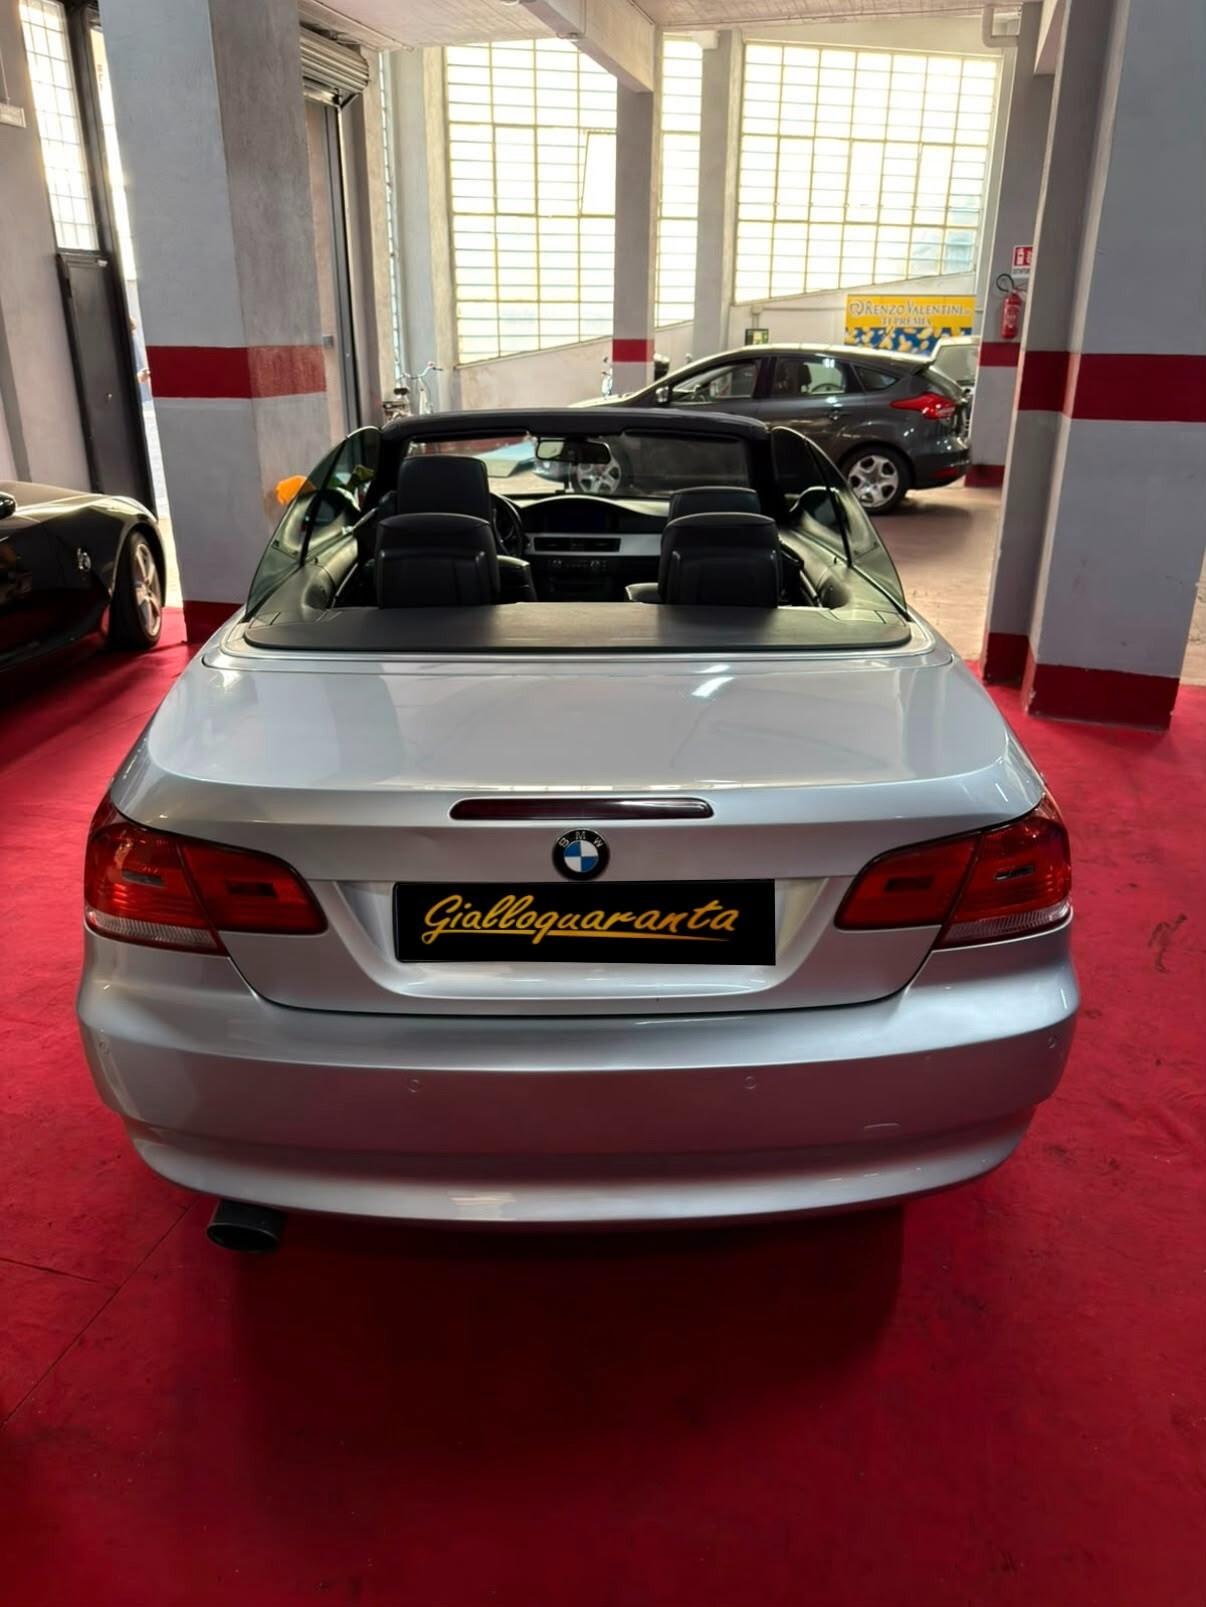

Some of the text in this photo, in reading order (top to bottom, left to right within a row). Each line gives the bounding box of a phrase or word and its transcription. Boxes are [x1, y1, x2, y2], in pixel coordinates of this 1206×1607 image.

[864, 301, 904, 315] RENZO
[906, 300, 963, 315] VALENTINI
[558, 830, 604, 848] BMW
[421, 894, 740, 945] Gialloquaranta
